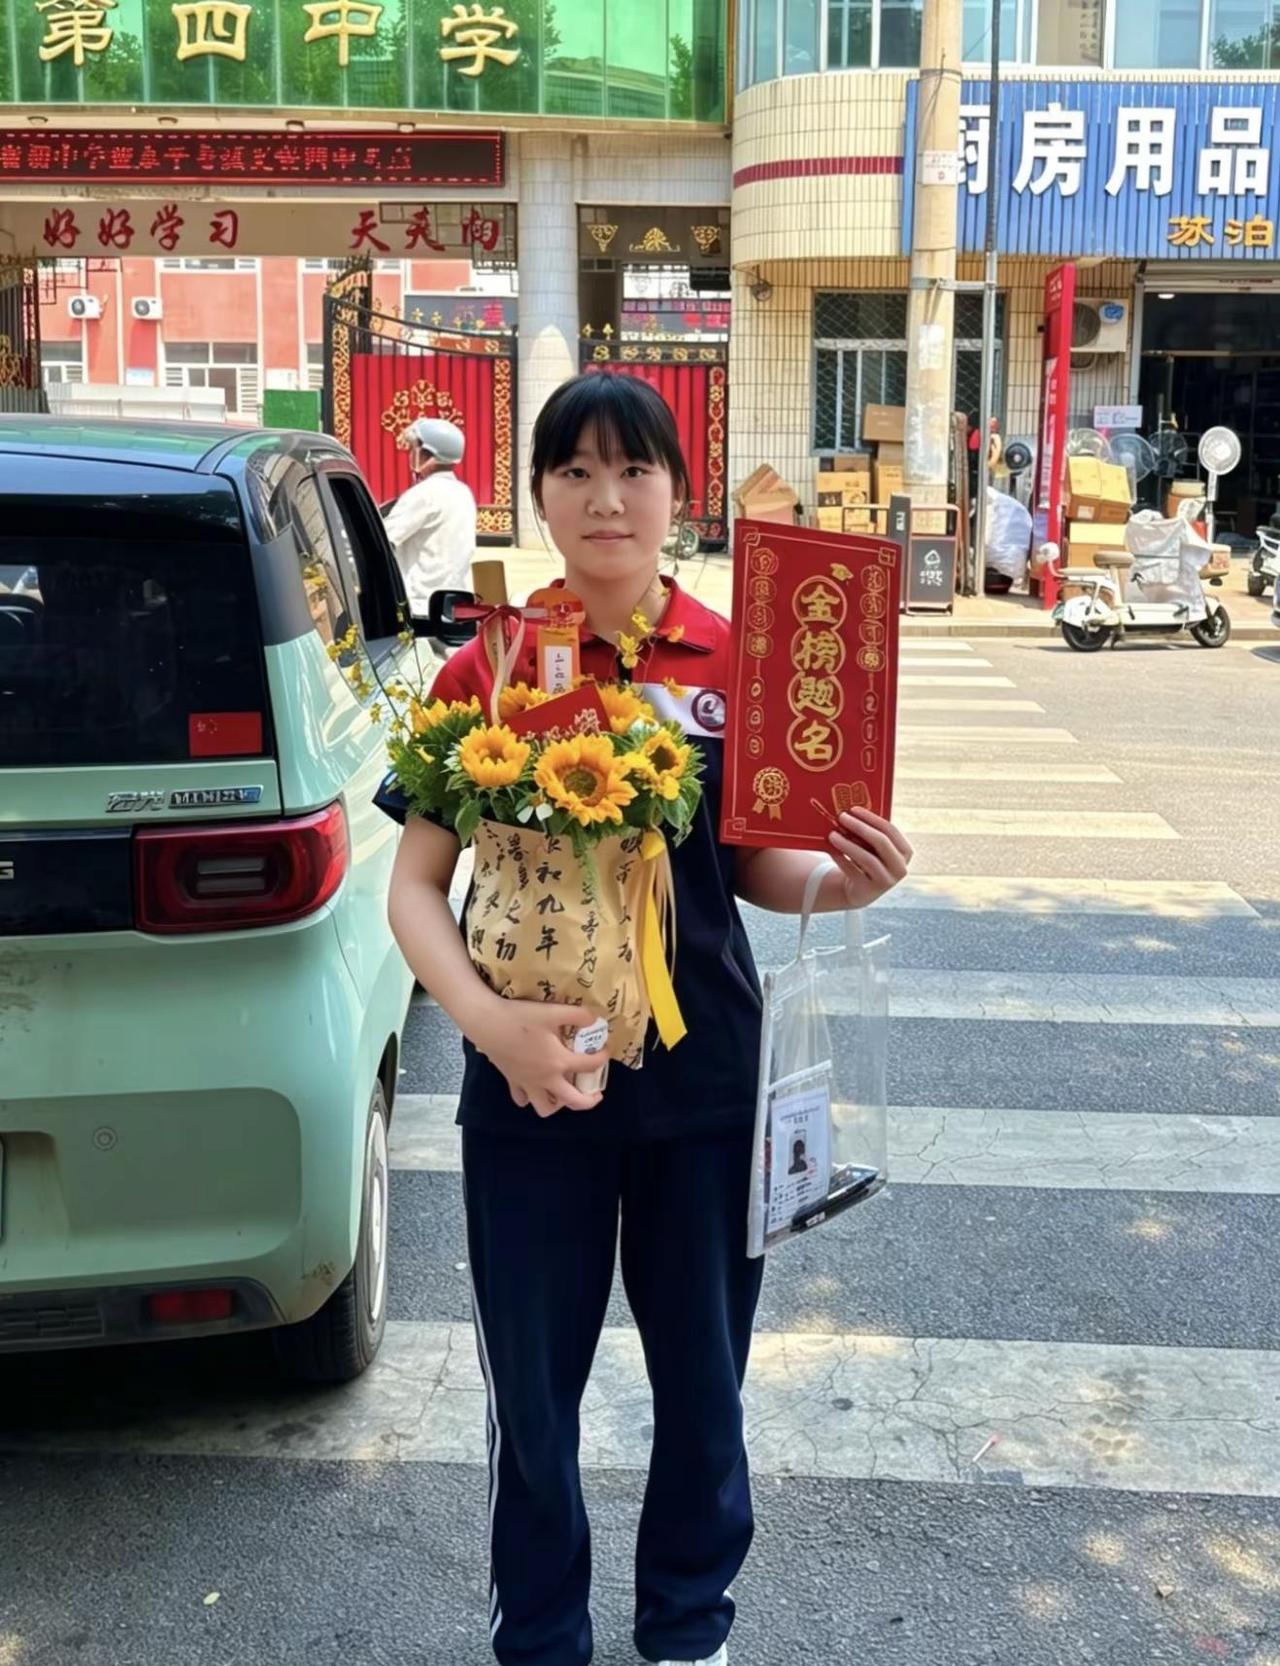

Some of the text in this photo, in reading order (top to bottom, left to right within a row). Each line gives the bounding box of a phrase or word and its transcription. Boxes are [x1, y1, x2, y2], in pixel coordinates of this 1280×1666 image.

[35, 0, 521, 76] 第四中学
[43, 204, 239, 250] 好好学习
[1167, 214, 1274, 248] 苏泊
[794, 584, 841, 762] 金榜题名
